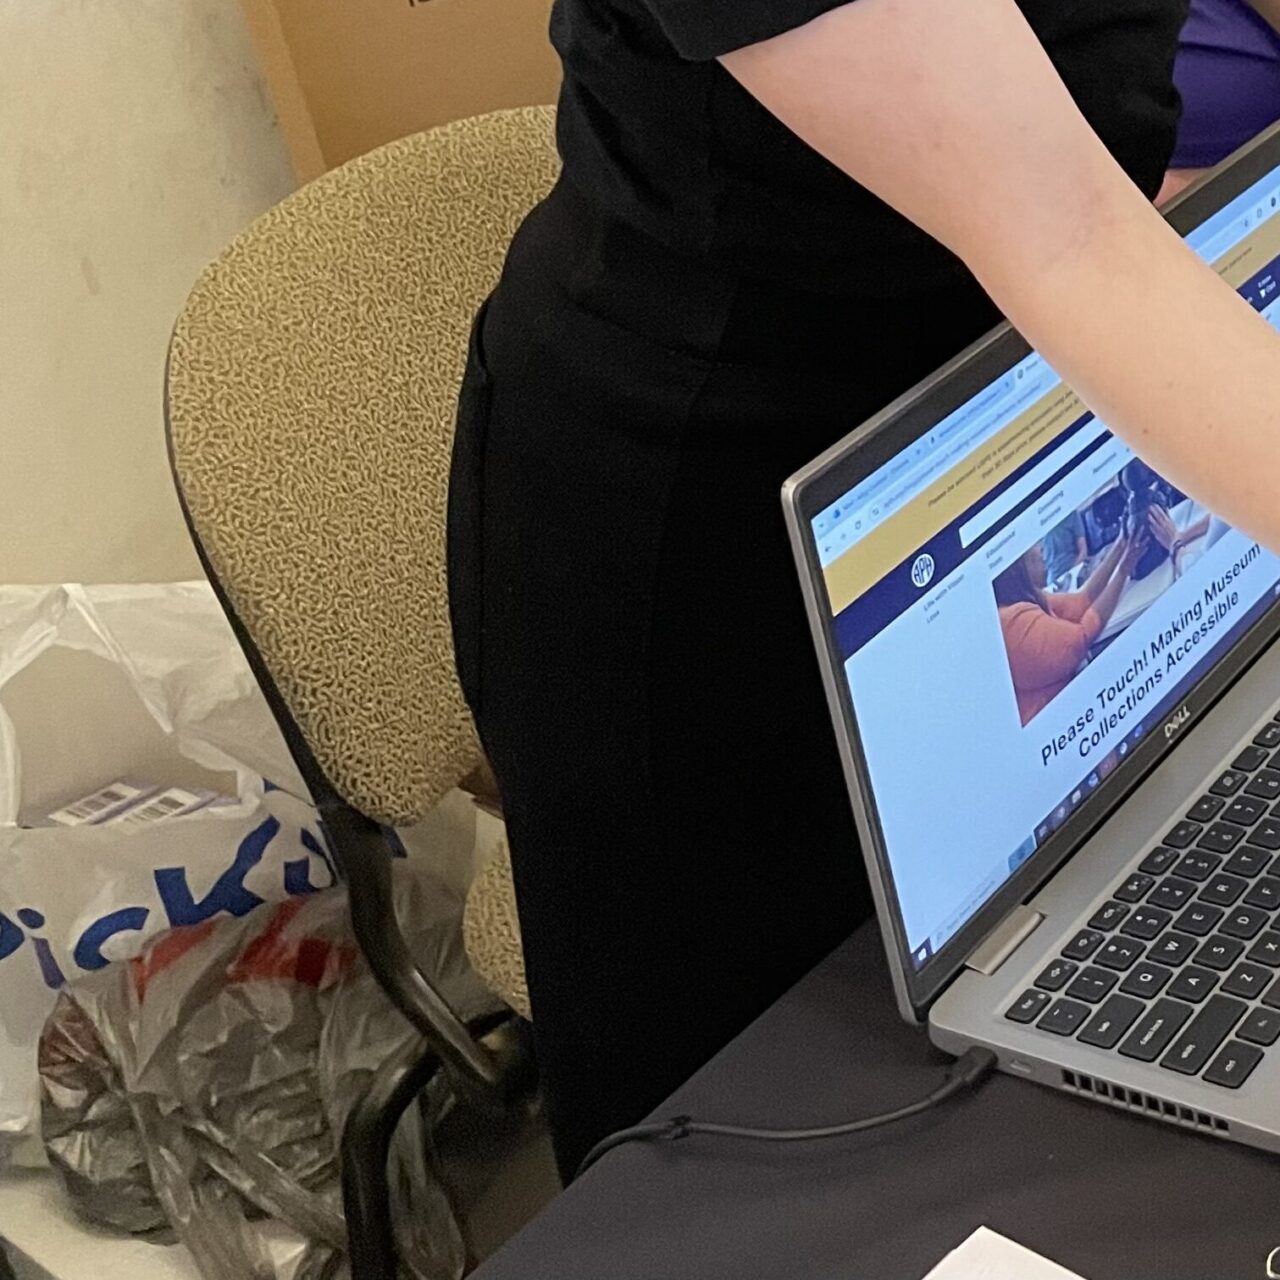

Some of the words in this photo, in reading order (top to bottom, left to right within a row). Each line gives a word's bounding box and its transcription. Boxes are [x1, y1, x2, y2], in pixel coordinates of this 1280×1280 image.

[912, 554, 934, 587] APH
[1041, 707, 1095, 766] Please
[1096, 649, 1147, 710] Touch!
[1150, 603, 1203, 660] Making
[1203, 542, 1262, 607] Museum
[1078, 669, 1163, 758] Collections
[1165, 590, 1240, 668] Accessible
[1163, 705, 1191, 738] DELL
